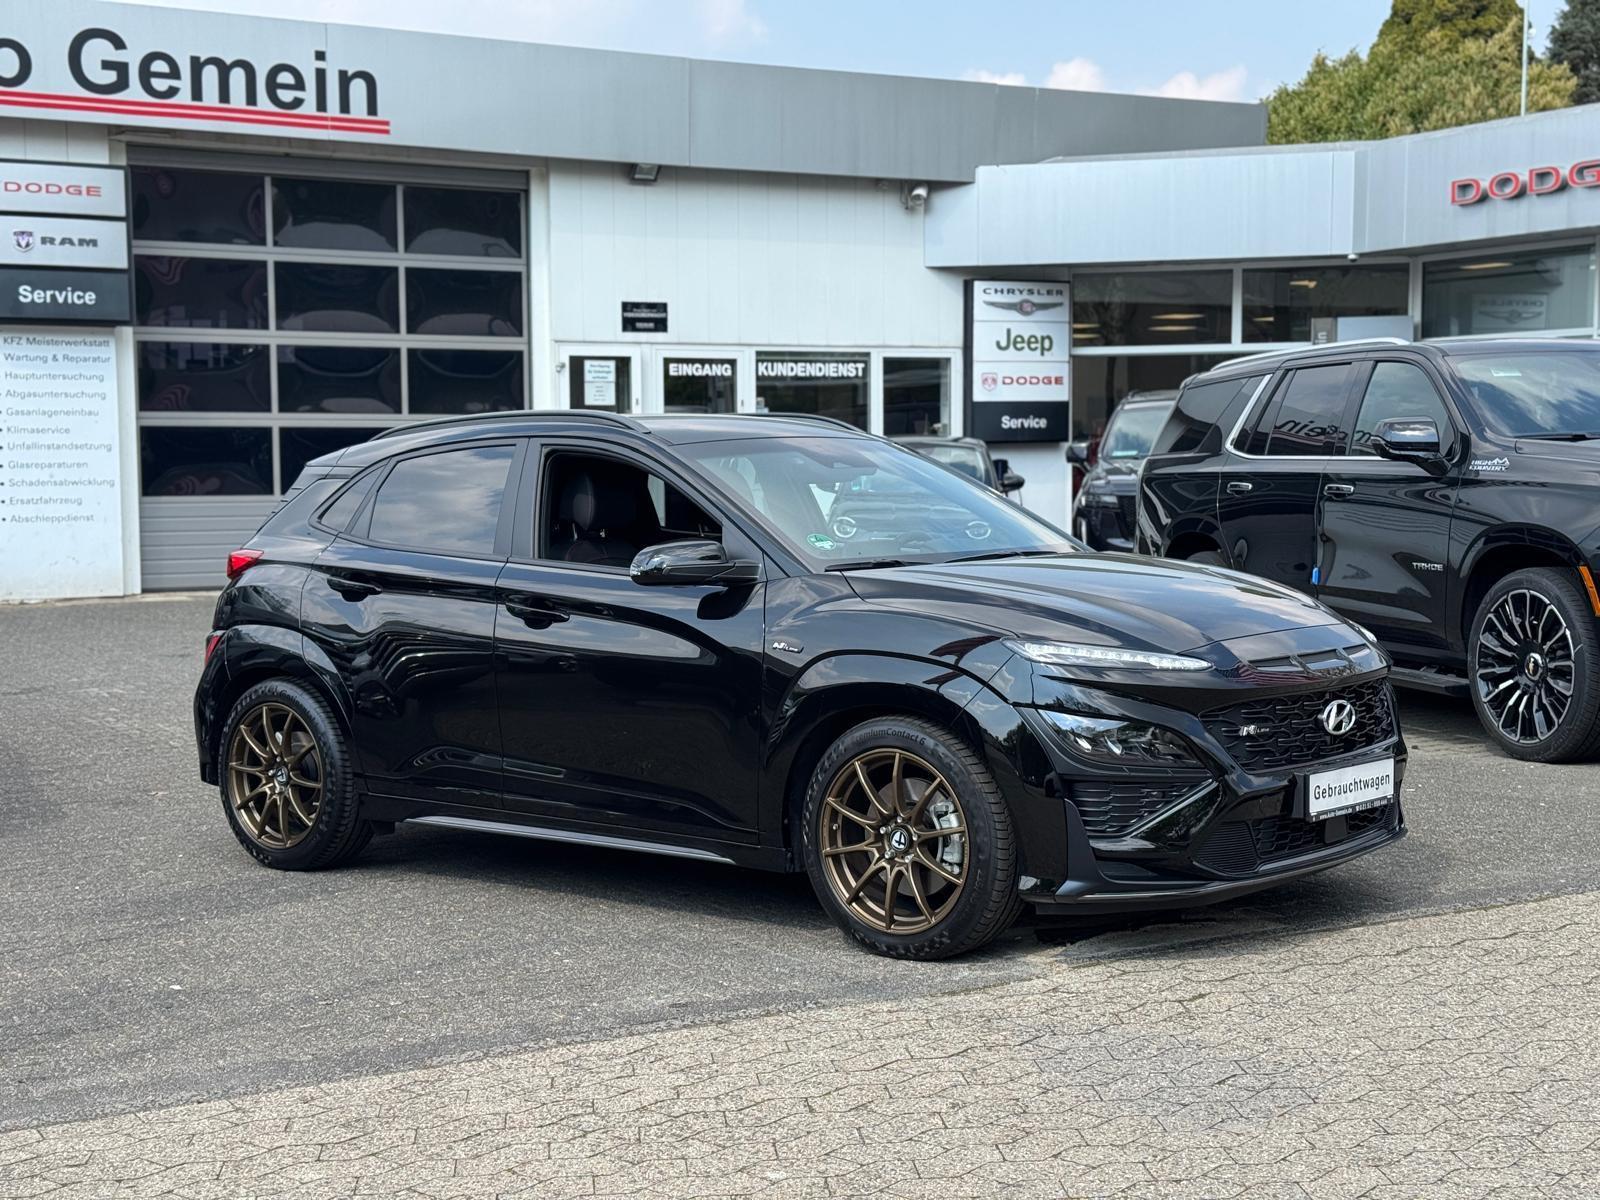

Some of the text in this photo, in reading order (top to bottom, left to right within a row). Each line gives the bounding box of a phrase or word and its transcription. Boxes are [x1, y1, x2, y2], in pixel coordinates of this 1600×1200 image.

[68, 28, 378, 116] Gemein
[4, 181, 102, 197] DODGE
[40, 236, 98, 247] RAM
[18, 285, 96, 305] Service
[982, 288, 1064, 296] CHRYSLER
[3, 336, 110, 347] KFZ Meisterwerkstatt
[996, 328, 1053, 356] Jeep
[4, 353, 111, 364] Wartung & Reparatur
[668, 362, 865, 378] EINGANG KUNDENDIENST
[5, 371, 104, 382] Hauptuntersuchung
[1002, 376, 1064, 386] DODGE
[5, 390, 106, 400] Abgasuntersuchung
[6, 407, 99, 418] Gasanlageneinbau
[1001, 415, 1047, 429] Service
[7, 426, 70, 435] Klimaservice
[7, 442, 112, 452] Unfallinstandsetzung
[8, 460, 88, 470] Glasreparaturen
[8, 478, 115, 488] Schadensabwicklung
[9, 496, 82, 506] Ersatzfahrzeug
[10, 514, 94, 524] Abschleppdienst
[1412, 562, 1443, 571] TAHOE
[919, 737, 926, 746] 6
[1314, 773, 1390, 800] Gebrauchtwagen
